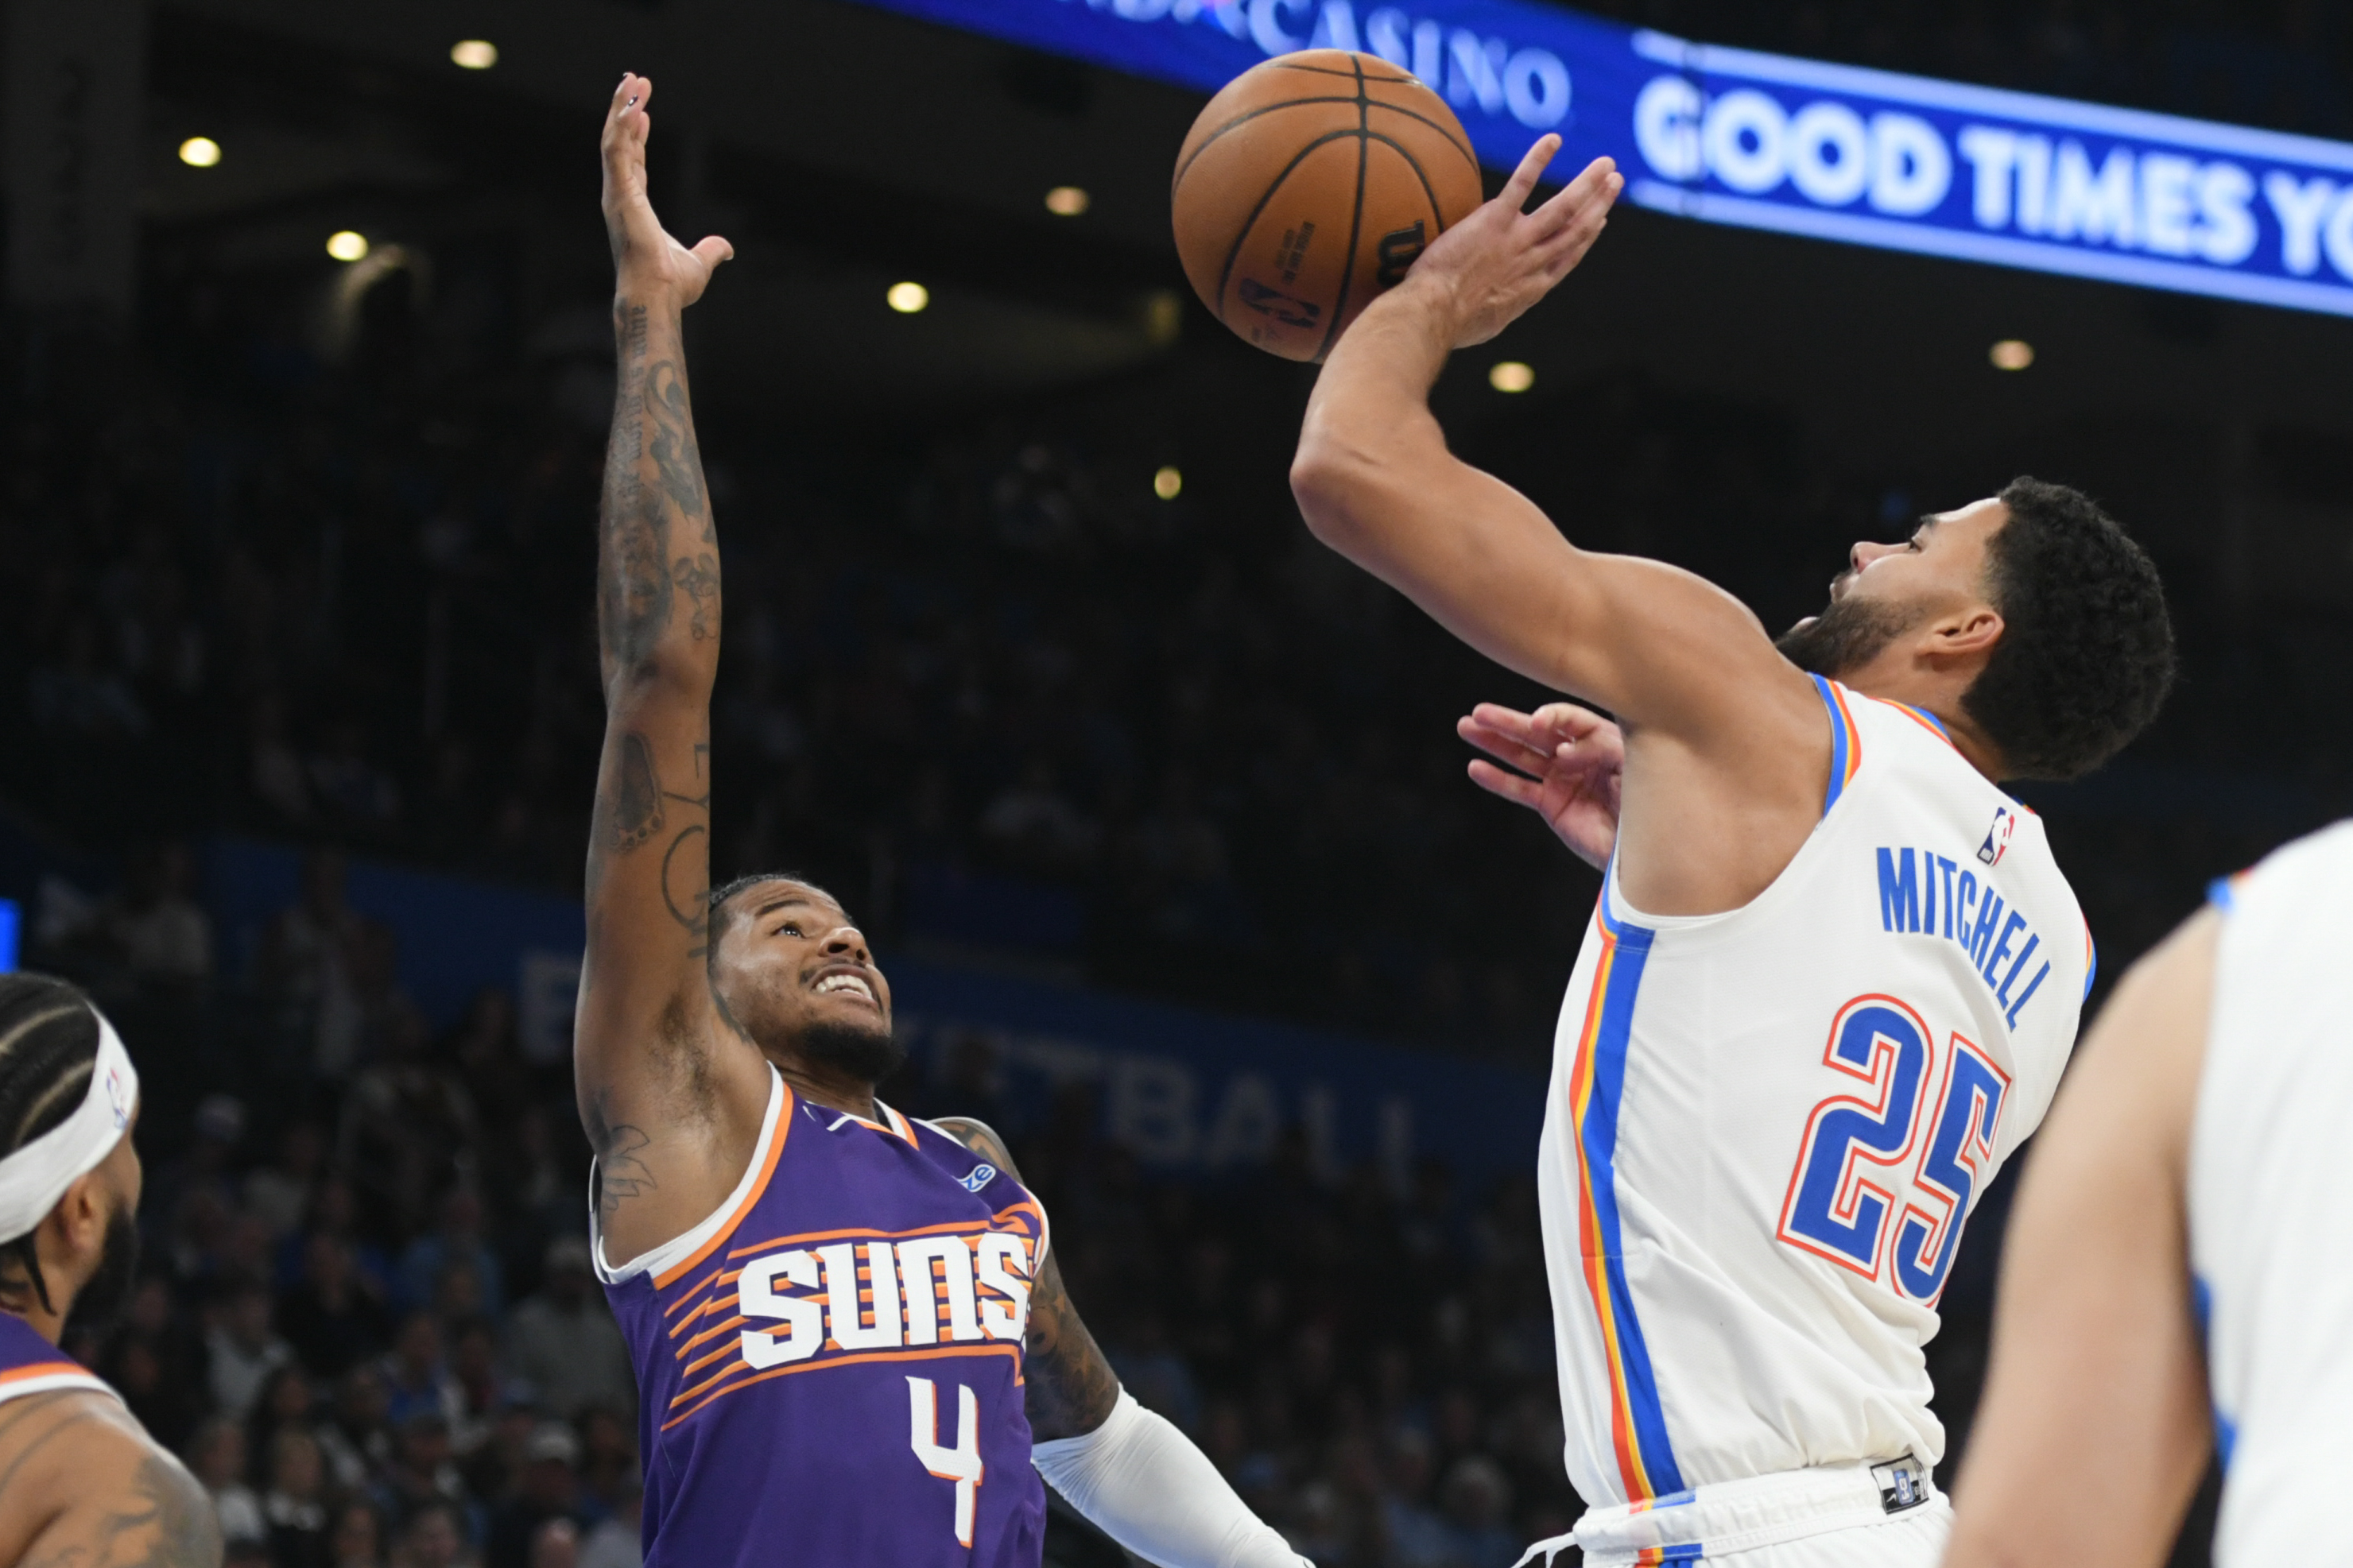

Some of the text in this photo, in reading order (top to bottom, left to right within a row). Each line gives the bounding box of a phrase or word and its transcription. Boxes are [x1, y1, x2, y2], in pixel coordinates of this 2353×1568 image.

[1249, 0, 1572, 129] CASINO
[1633, 75, 1955, 217] GOOD
[1957, 126, 2258, 265] TIMES
[1876, 846, 2051, 1033] MITCHELL
[1776, 993, 2012, 1308] 25
[738, 1232, 1030, 1369] SUNS
[905, 1375, 984, 1550] 4
